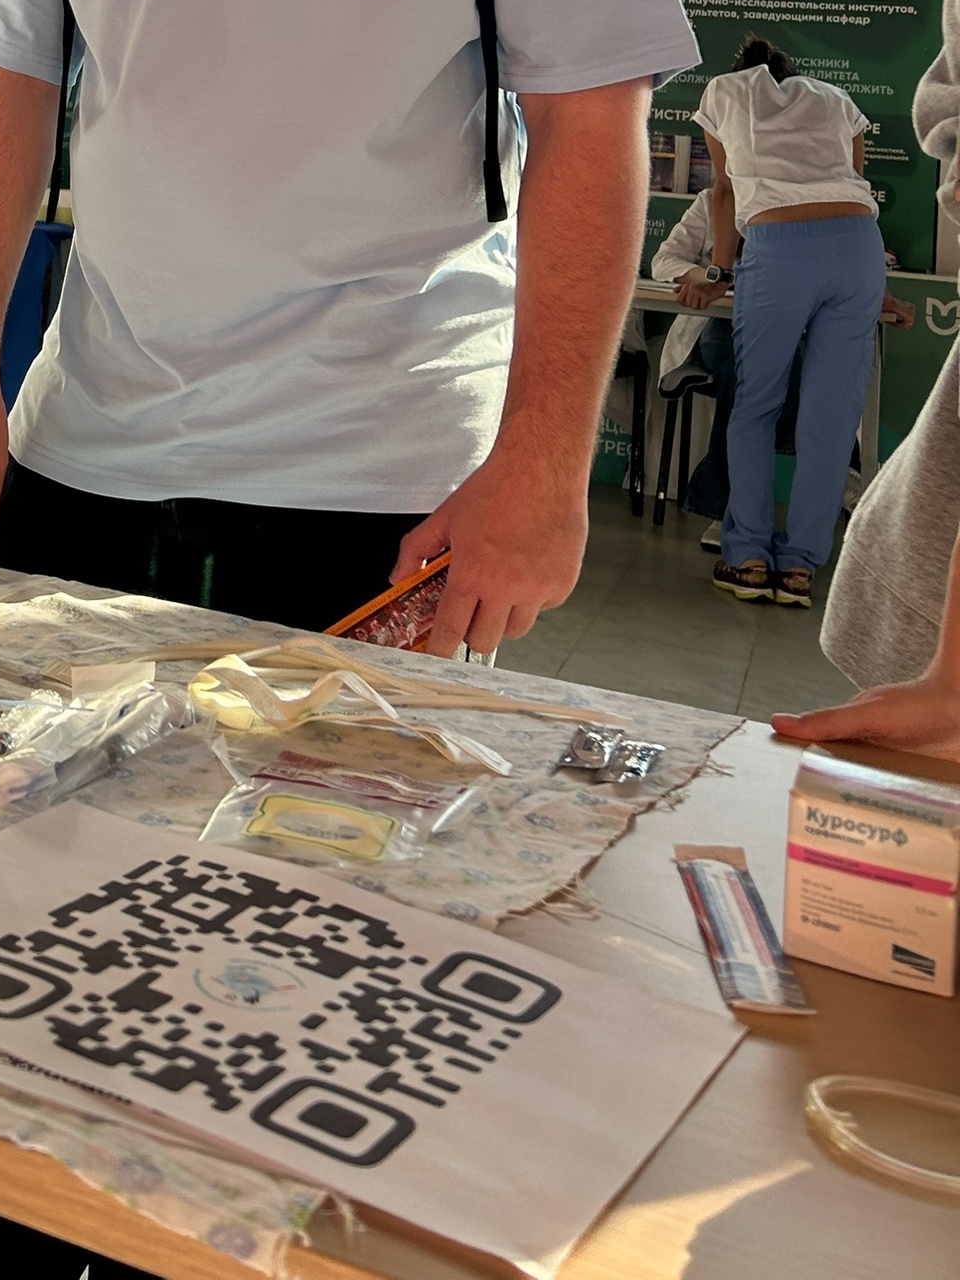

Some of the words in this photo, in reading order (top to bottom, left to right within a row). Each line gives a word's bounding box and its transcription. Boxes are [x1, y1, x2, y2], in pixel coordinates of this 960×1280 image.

[848, 3, 918, 15] институтов,
[743, 11, 823, 23] заведующими
[826, 14, 871, 26] кафедр
[805, 806, 909, 847] Куросурф
